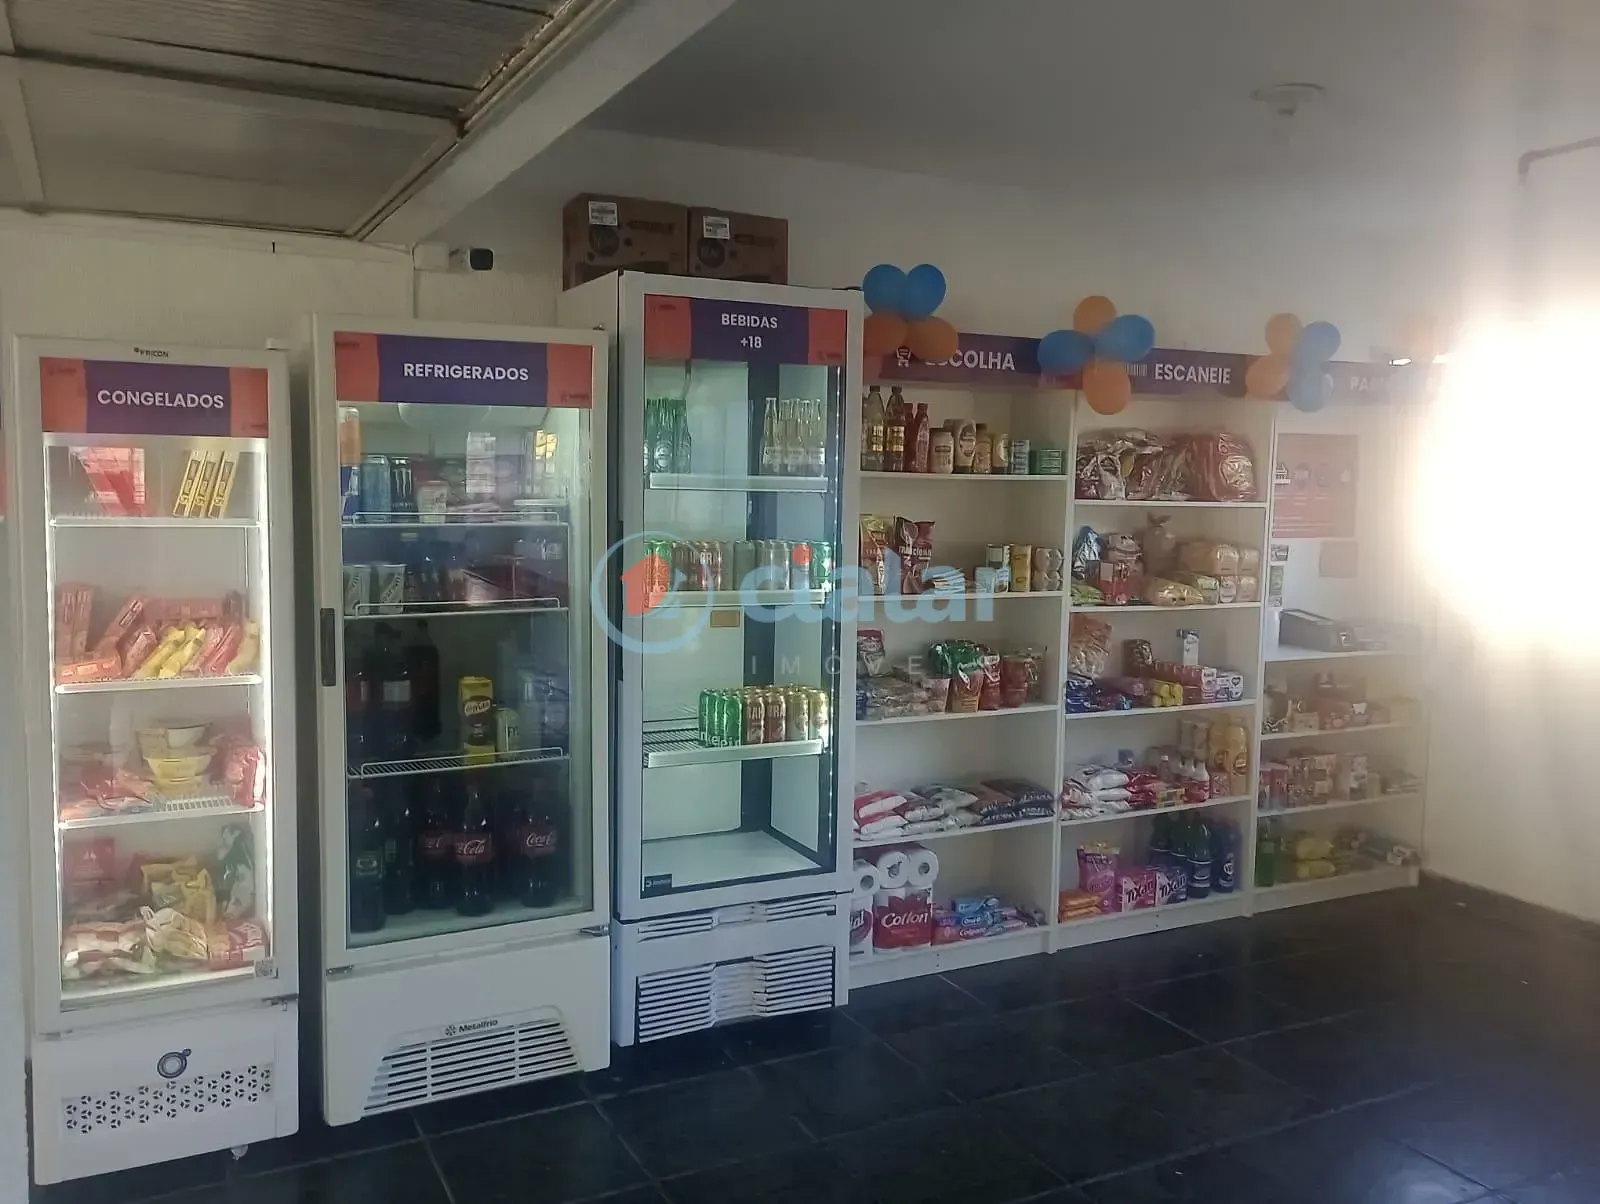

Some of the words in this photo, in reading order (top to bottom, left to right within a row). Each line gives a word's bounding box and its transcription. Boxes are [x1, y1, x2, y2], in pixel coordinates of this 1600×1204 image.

[721, 313, 778, 329] BEBIDAS
[740, 335, 762, 349] +18
[924, 350, 1016, 371] COLHA
[403, 362, 529, 382] REFRIGERADOS
[1154, 363, 1231, 385] ESCANEIE
[97, 389, 225, 410] CONGELADOS
[458, 1019, 499, 1033] Metalfrio
